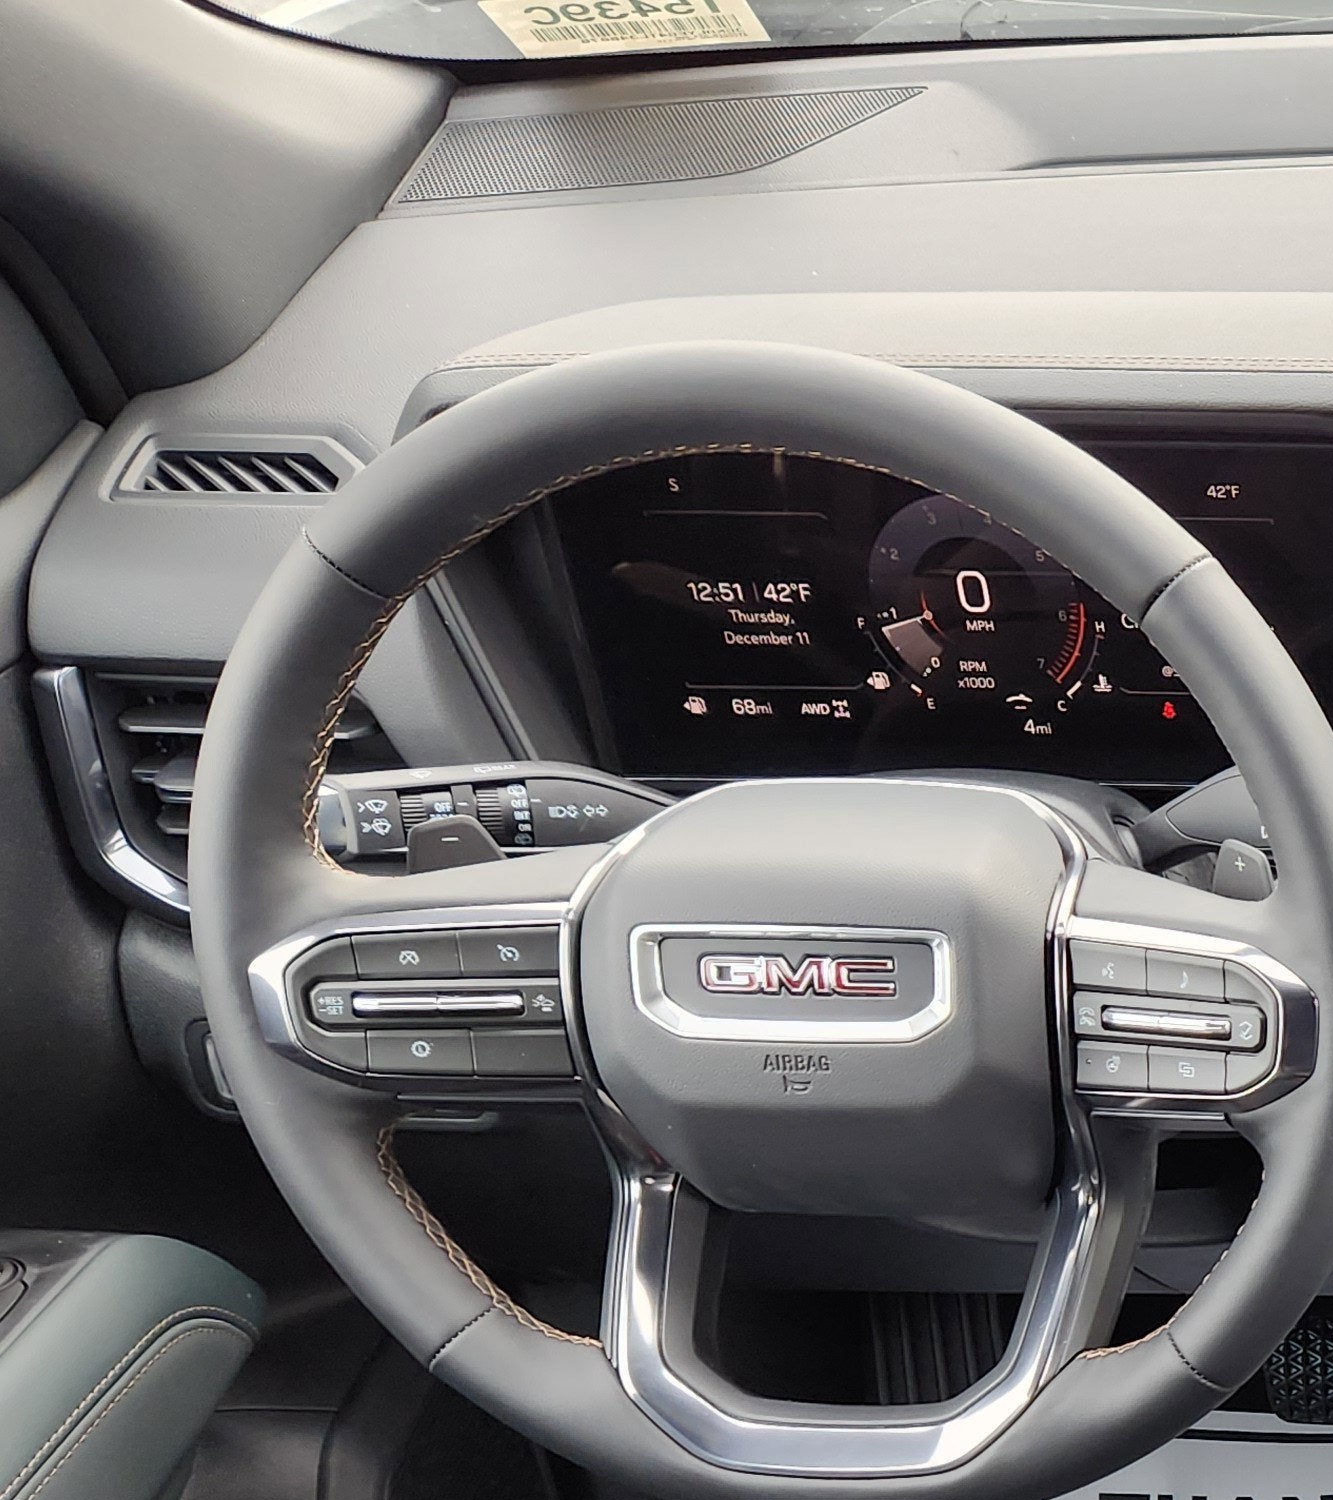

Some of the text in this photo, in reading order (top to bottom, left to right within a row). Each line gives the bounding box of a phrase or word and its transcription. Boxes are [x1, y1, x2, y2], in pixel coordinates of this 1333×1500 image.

[668, 477, 680, 491] S
[1206, 484, 1240, 498] 42°F
[1035, 551, 1044, 562] 5
[687, 582, 812, 603] 12:51 42°F
[956, 570, 991, 613] 0
[966, 621, 995, 632] MPH
[1094, 622, 1106, 633] H
[723, 631, 811, 645] December 11
[959, 661, 987, 672] RPM
[957, 678, 995, 689] x1000
[801, 702, 831, 715] AWD
[926, 698, 936, 710] E
[1057, 701, 1067, 712] C
[699, 953, 897, 997] GMC
[763, 1054, 831, 1072] AIRBAG
